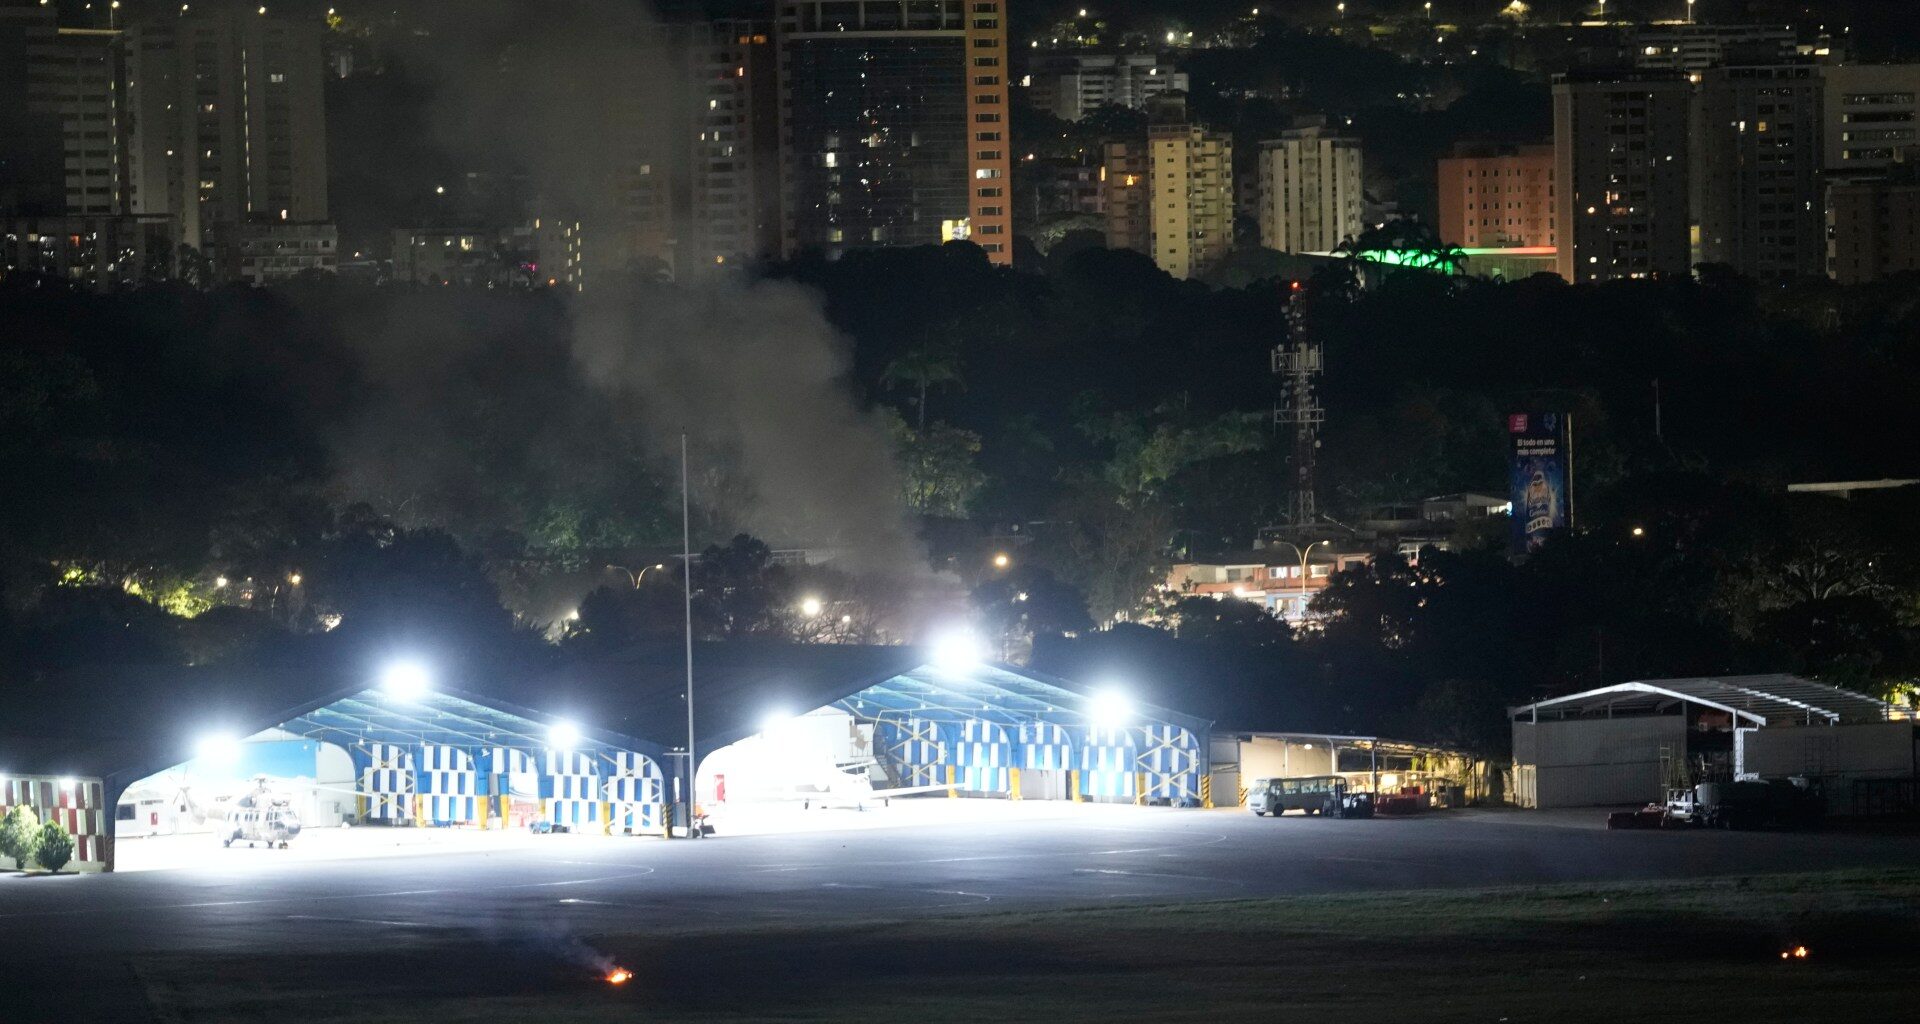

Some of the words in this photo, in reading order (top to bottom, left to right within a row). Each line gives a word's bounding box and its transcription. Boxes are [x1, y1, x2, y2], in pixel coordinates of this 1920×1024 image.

[1523, 438, 1536, 446] todo
[1517, 447, 1529, 456] más
[1530, 447, 1555, 457] completo
